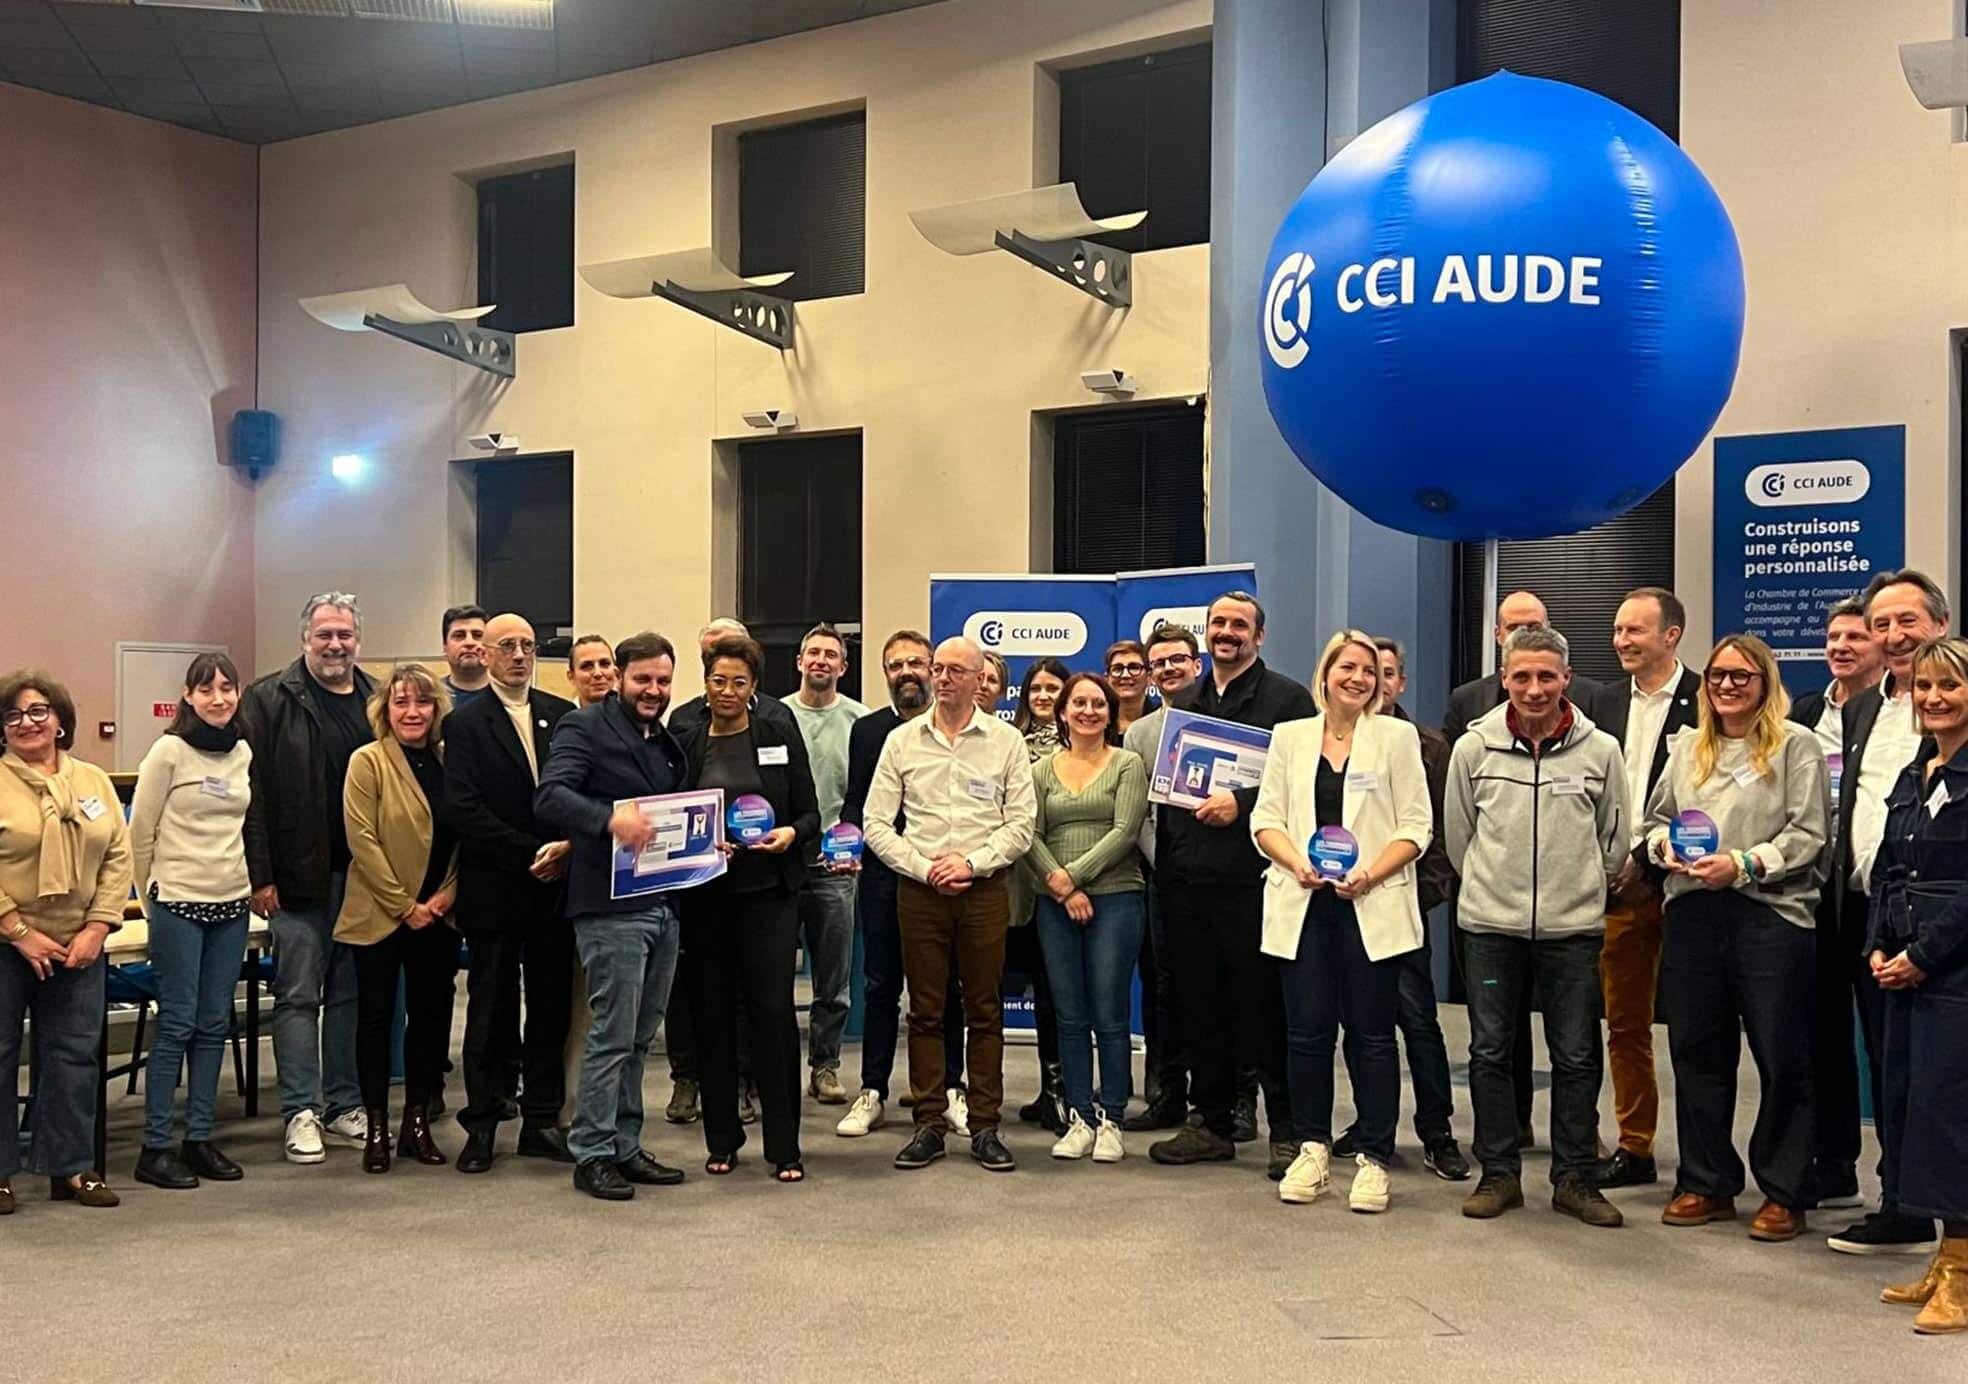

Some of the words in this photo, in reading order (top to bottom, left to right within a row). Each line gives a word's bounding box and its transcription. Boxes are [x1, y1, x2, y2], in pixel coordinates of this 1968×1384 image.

[1336, 256, 1415, 314] CCI
[1432, 254, 1602, 306] AUDE
[1793, 478, 1814, 490] CCI
[1817, 475, 1854, 489] AUDE
[1744, 517, 1861, 537] Construisons
[1744, 543, 1778, 556] une
[1782, 538, 1854, 558] réponse
[1744, 556, 1870, 578] personnalisée
[1757, 588, 1796, 599] Chambre
[1798, 587, 1809, 598] de
[1811, 587, 1859, 598] Commerce
[1797, 601, 1809, 611] de
[1744, 615, 1802, 627] accompagne
[1807, 615, 1820, 624] au
[1011, 628, 1032, 640] CCI
[1035, 628, 1072, 640] AUDE
